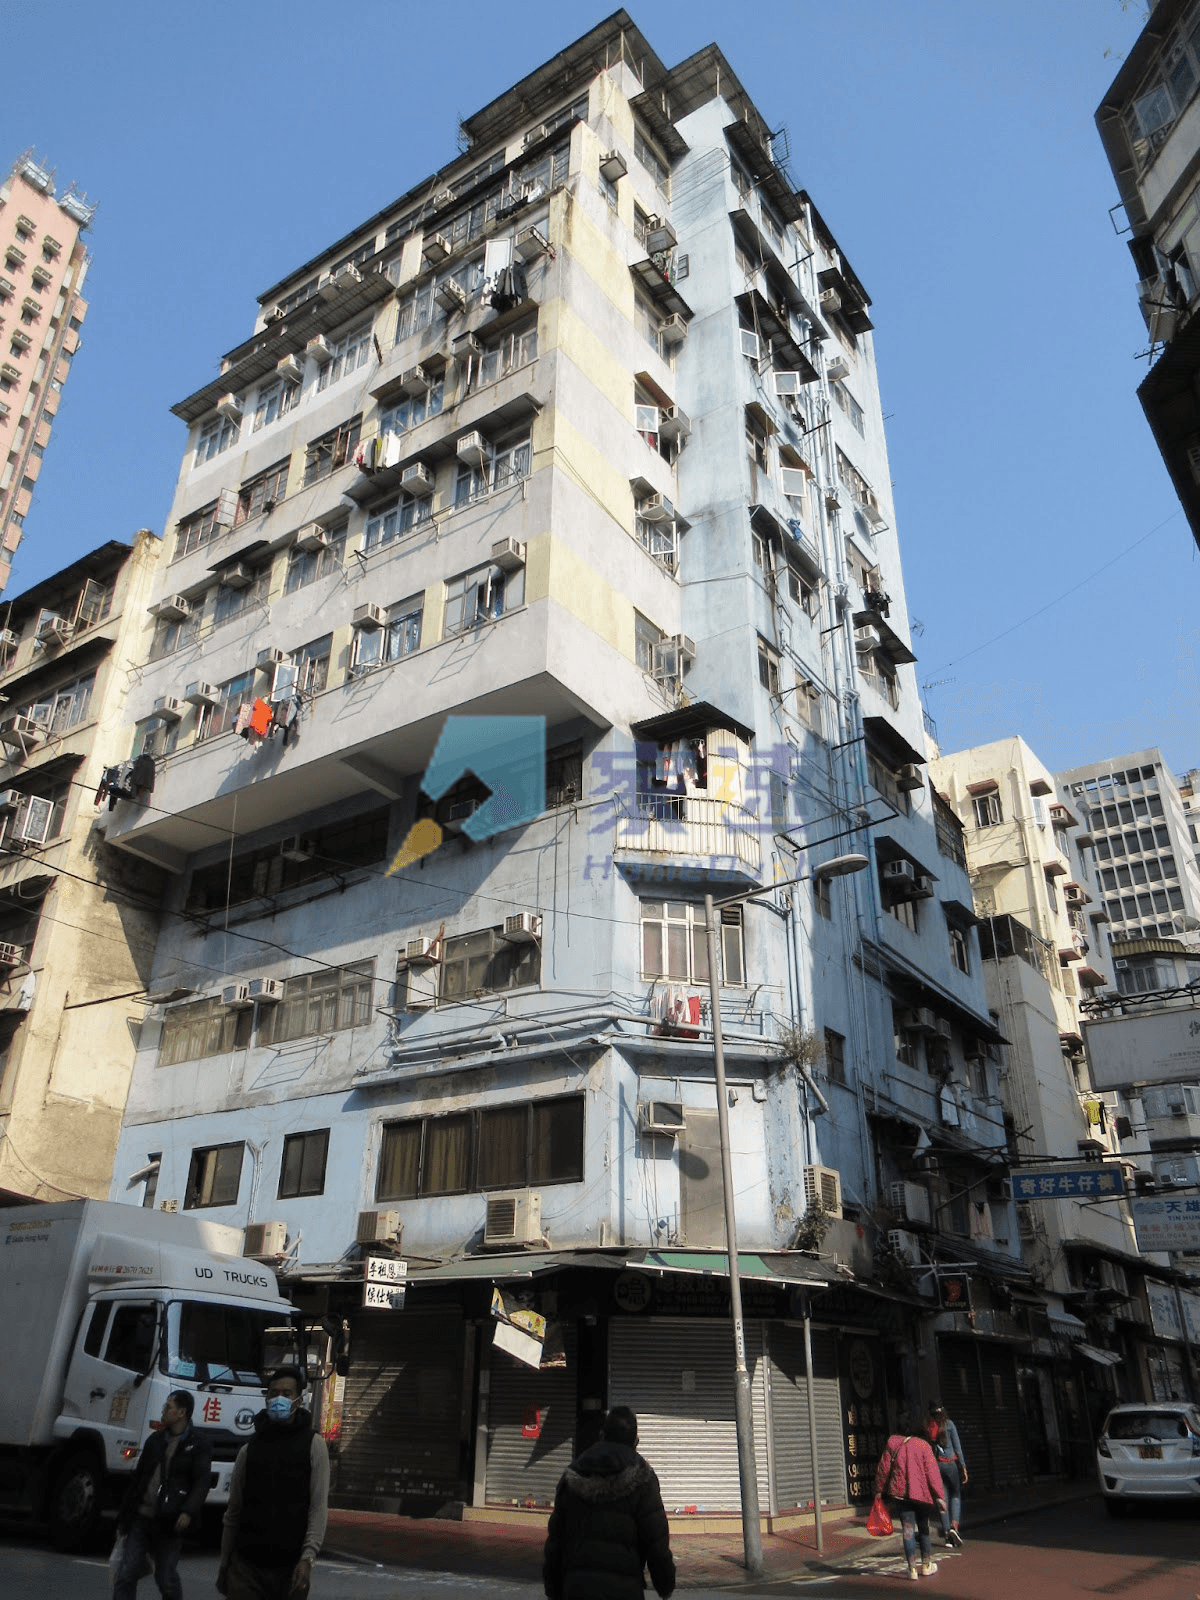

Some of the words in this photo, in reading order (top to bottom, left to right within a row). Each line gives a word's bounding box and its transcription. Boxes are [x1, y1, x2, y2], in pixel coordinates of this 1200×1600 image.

[1020, 1173, 1116, 1195] 奇好牛仔褲
[195, 1267, 213, 1279] UD
[223, 1270, 268, 1288] TRUCKS
[202, 1396, 222, 1423] 佳
